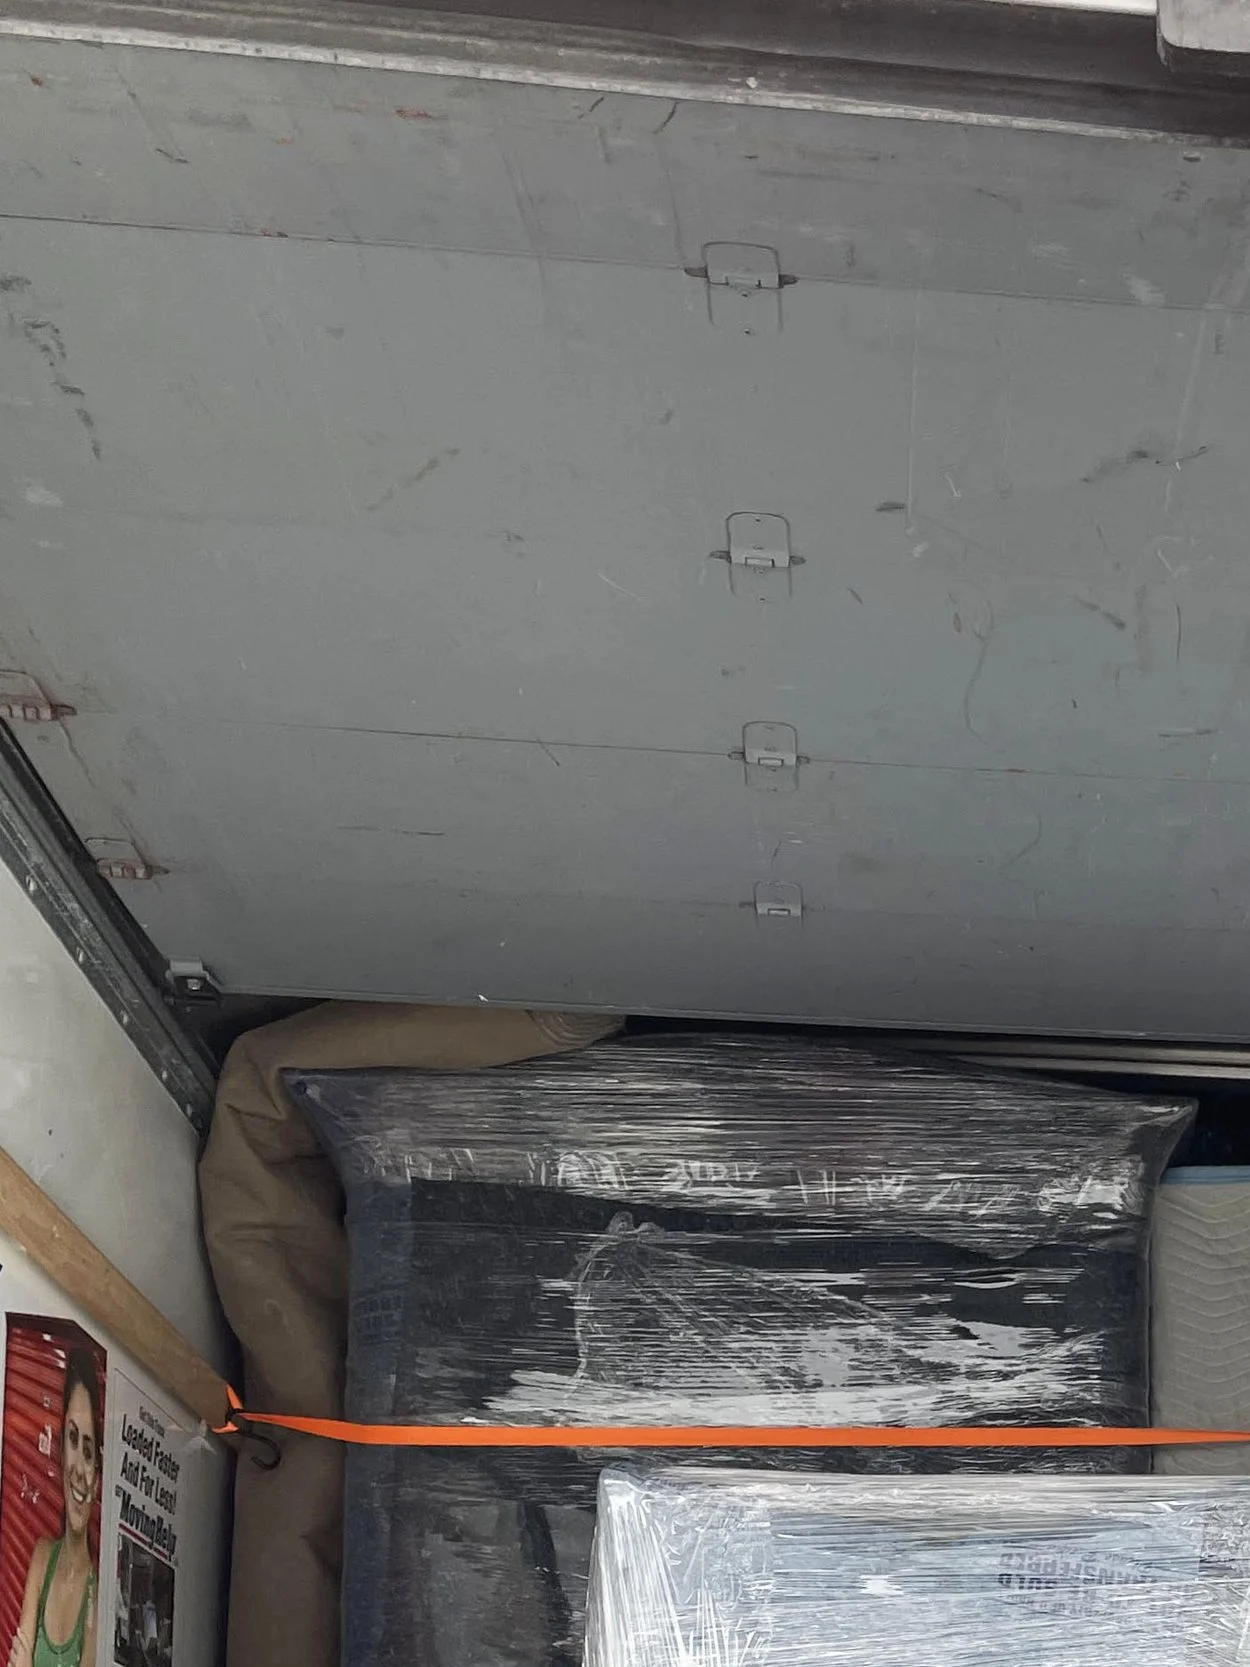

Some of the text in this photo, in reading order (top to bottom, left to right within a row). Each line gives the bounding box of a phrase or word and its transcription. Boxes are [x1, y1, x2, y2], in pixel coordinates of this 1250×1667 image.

[121, 1413, 155, 1462] Loaded
[154, 1441, 180, 1484] Faster
[120, 1452, 177, 1516] And For Less!
